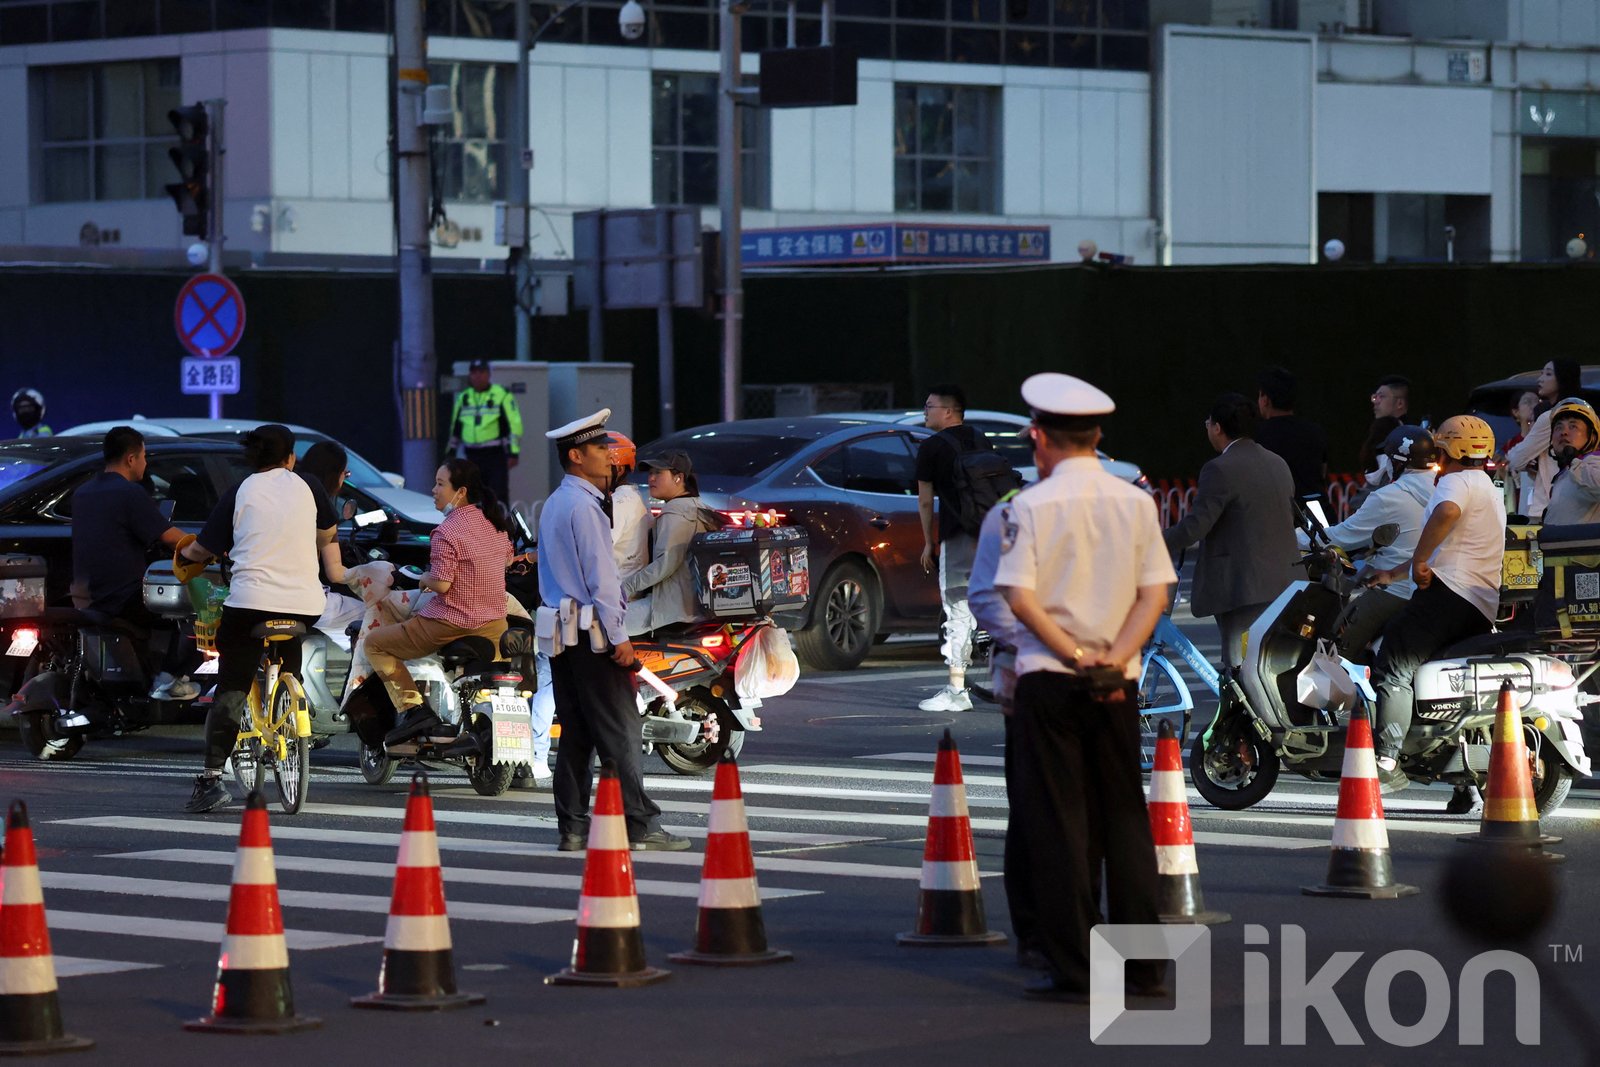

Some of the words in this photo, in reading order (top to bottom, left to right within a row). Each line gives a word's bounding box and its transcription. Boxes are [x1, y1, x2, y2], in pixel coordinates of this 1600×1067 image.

[934, 233, 1013, 254] 加强用电安全
[187, 364, 234, 387] 全路段
[1568, 602, 1600, 614] 加入骑
